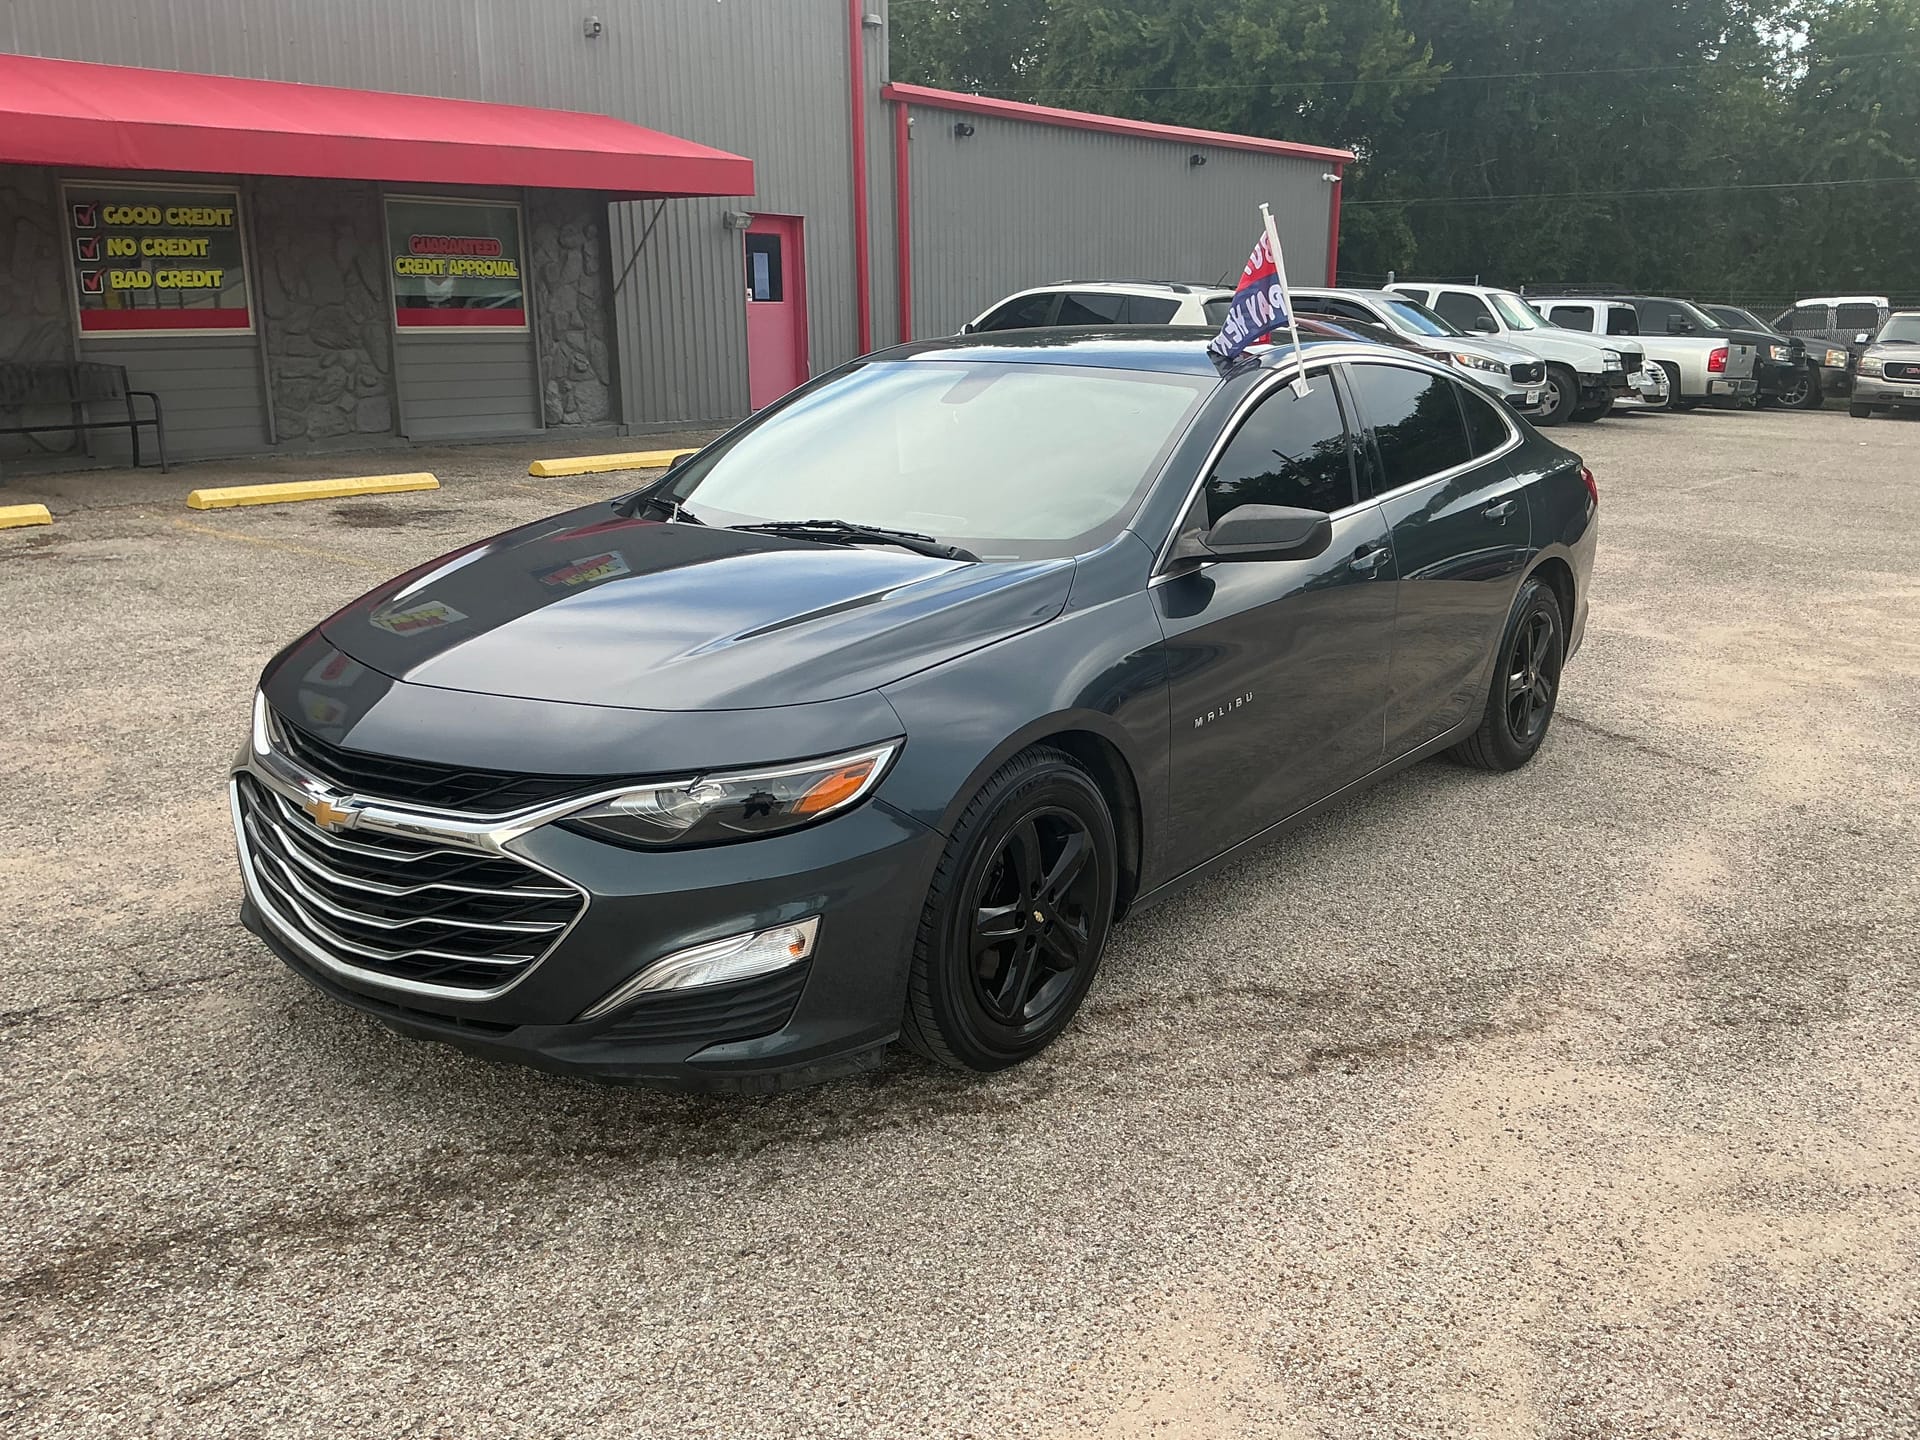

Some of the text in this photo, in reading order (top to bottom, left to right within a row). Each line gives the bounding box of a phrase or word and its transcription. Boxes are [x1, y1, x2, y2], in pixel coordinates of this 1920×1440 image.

[103, 206, 233, 226] GOOD CREDIT
[107, 238, 208, 257] NO CREDIT
[411, 236, 501, 256] GUARANTEED
[396, 257, 518, 277] CREDIT APPROVAL
[110, 270, 222, 289] BAD CREDIT
[1194, 691, 1253, 729] MALIBU
